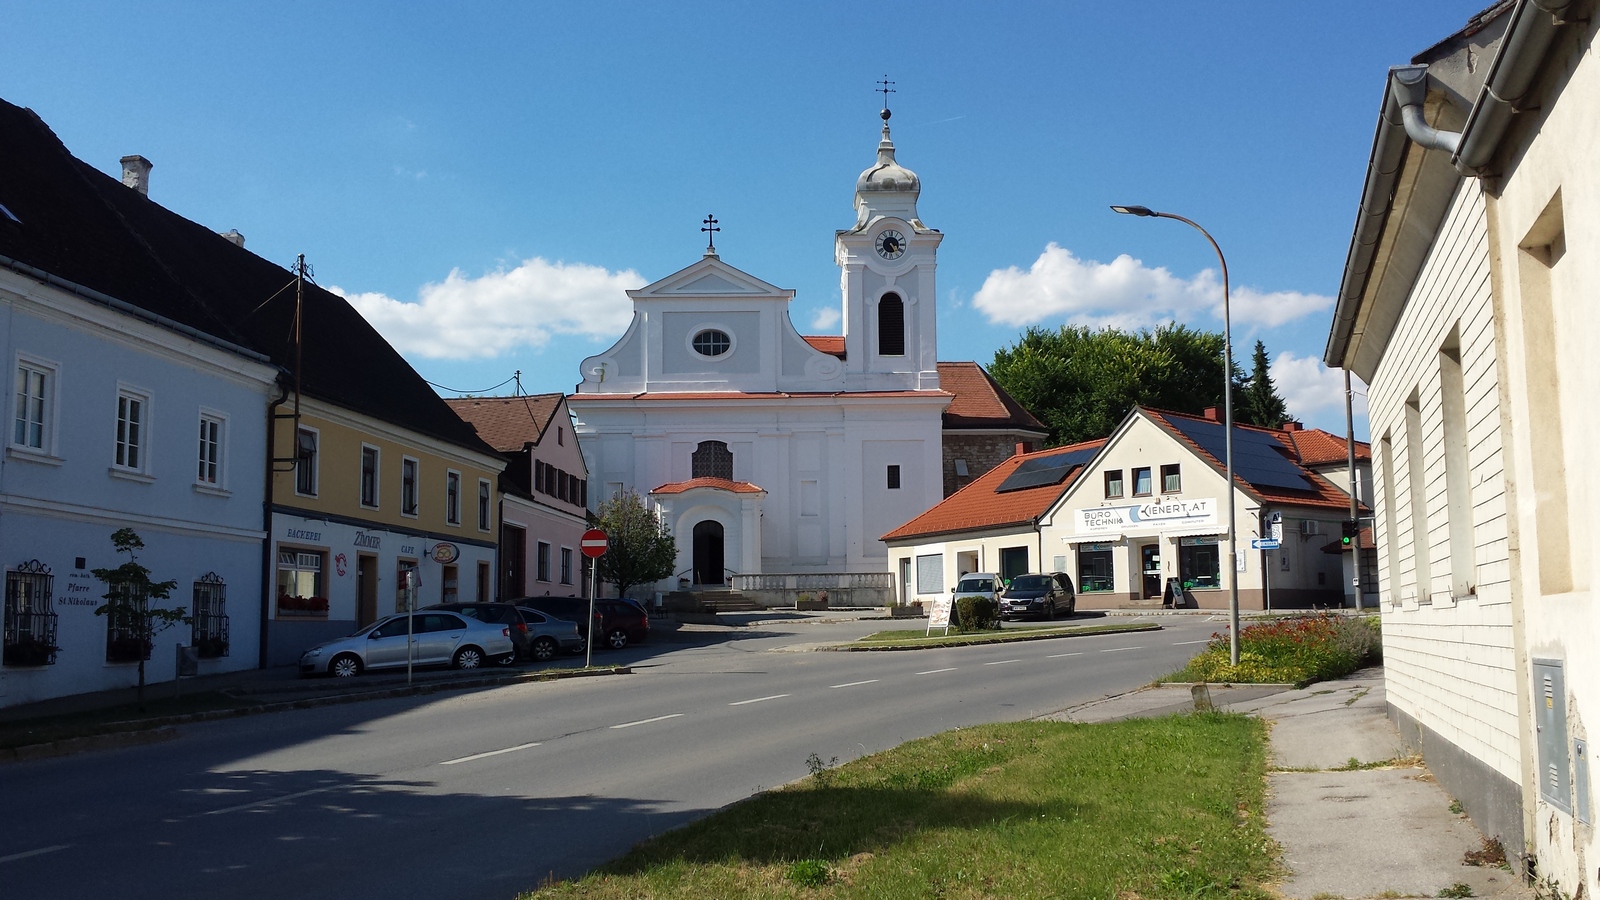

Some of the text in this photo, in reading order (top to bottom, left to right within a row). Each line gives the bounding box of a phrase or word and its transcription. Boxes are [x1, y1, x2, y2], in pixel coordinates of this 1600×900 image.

[1084, 511, 1111, 519] BÜRO
[1084, 517, 1122, 526] TECHNIK
[353, 530, 382, 550] ZIMMER
[68, 583, 90, 592] Pfarre
[67, 597, 98, 606] Nikolaus
